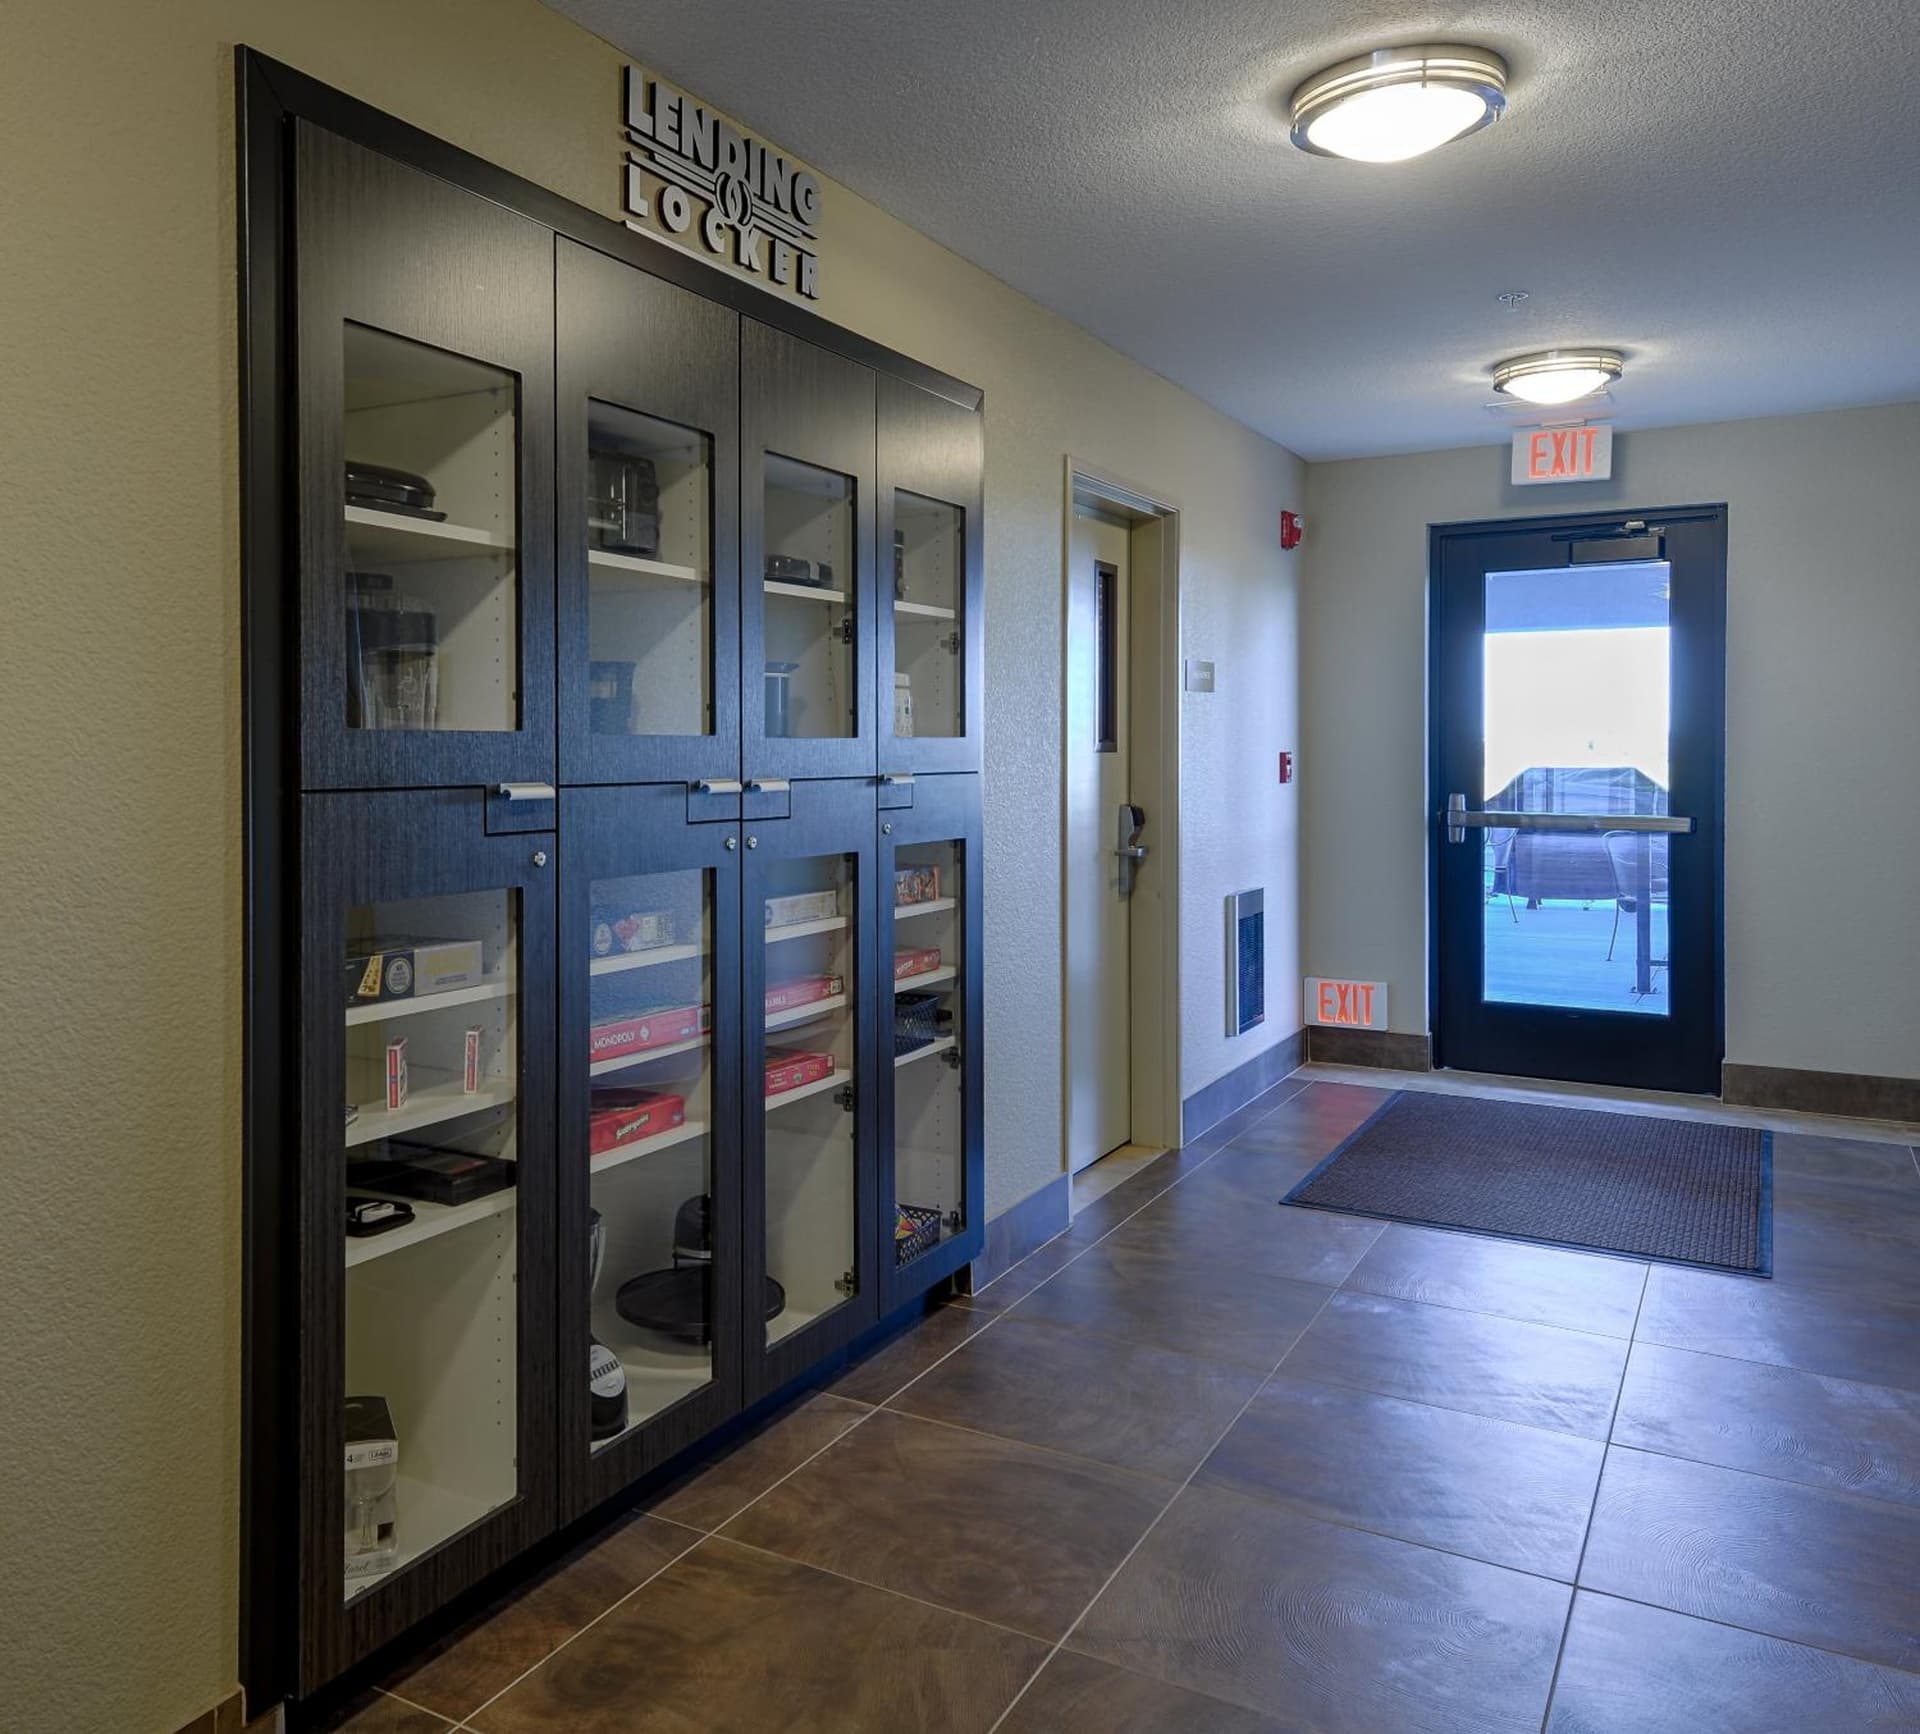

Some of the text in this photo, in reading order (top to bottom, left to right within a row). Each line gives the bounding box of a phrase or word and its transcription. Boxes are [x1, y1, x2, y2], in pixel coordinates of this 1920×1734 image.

[623, 65, 821, 225] LENDING
[624, 163, 820, 300] LOCKER
[1529, 428, 1598, 478] EXIT
[1318, 981, 1375, 1025] EXIT
[594, 1031, 634, 1049] MONOPOLY
